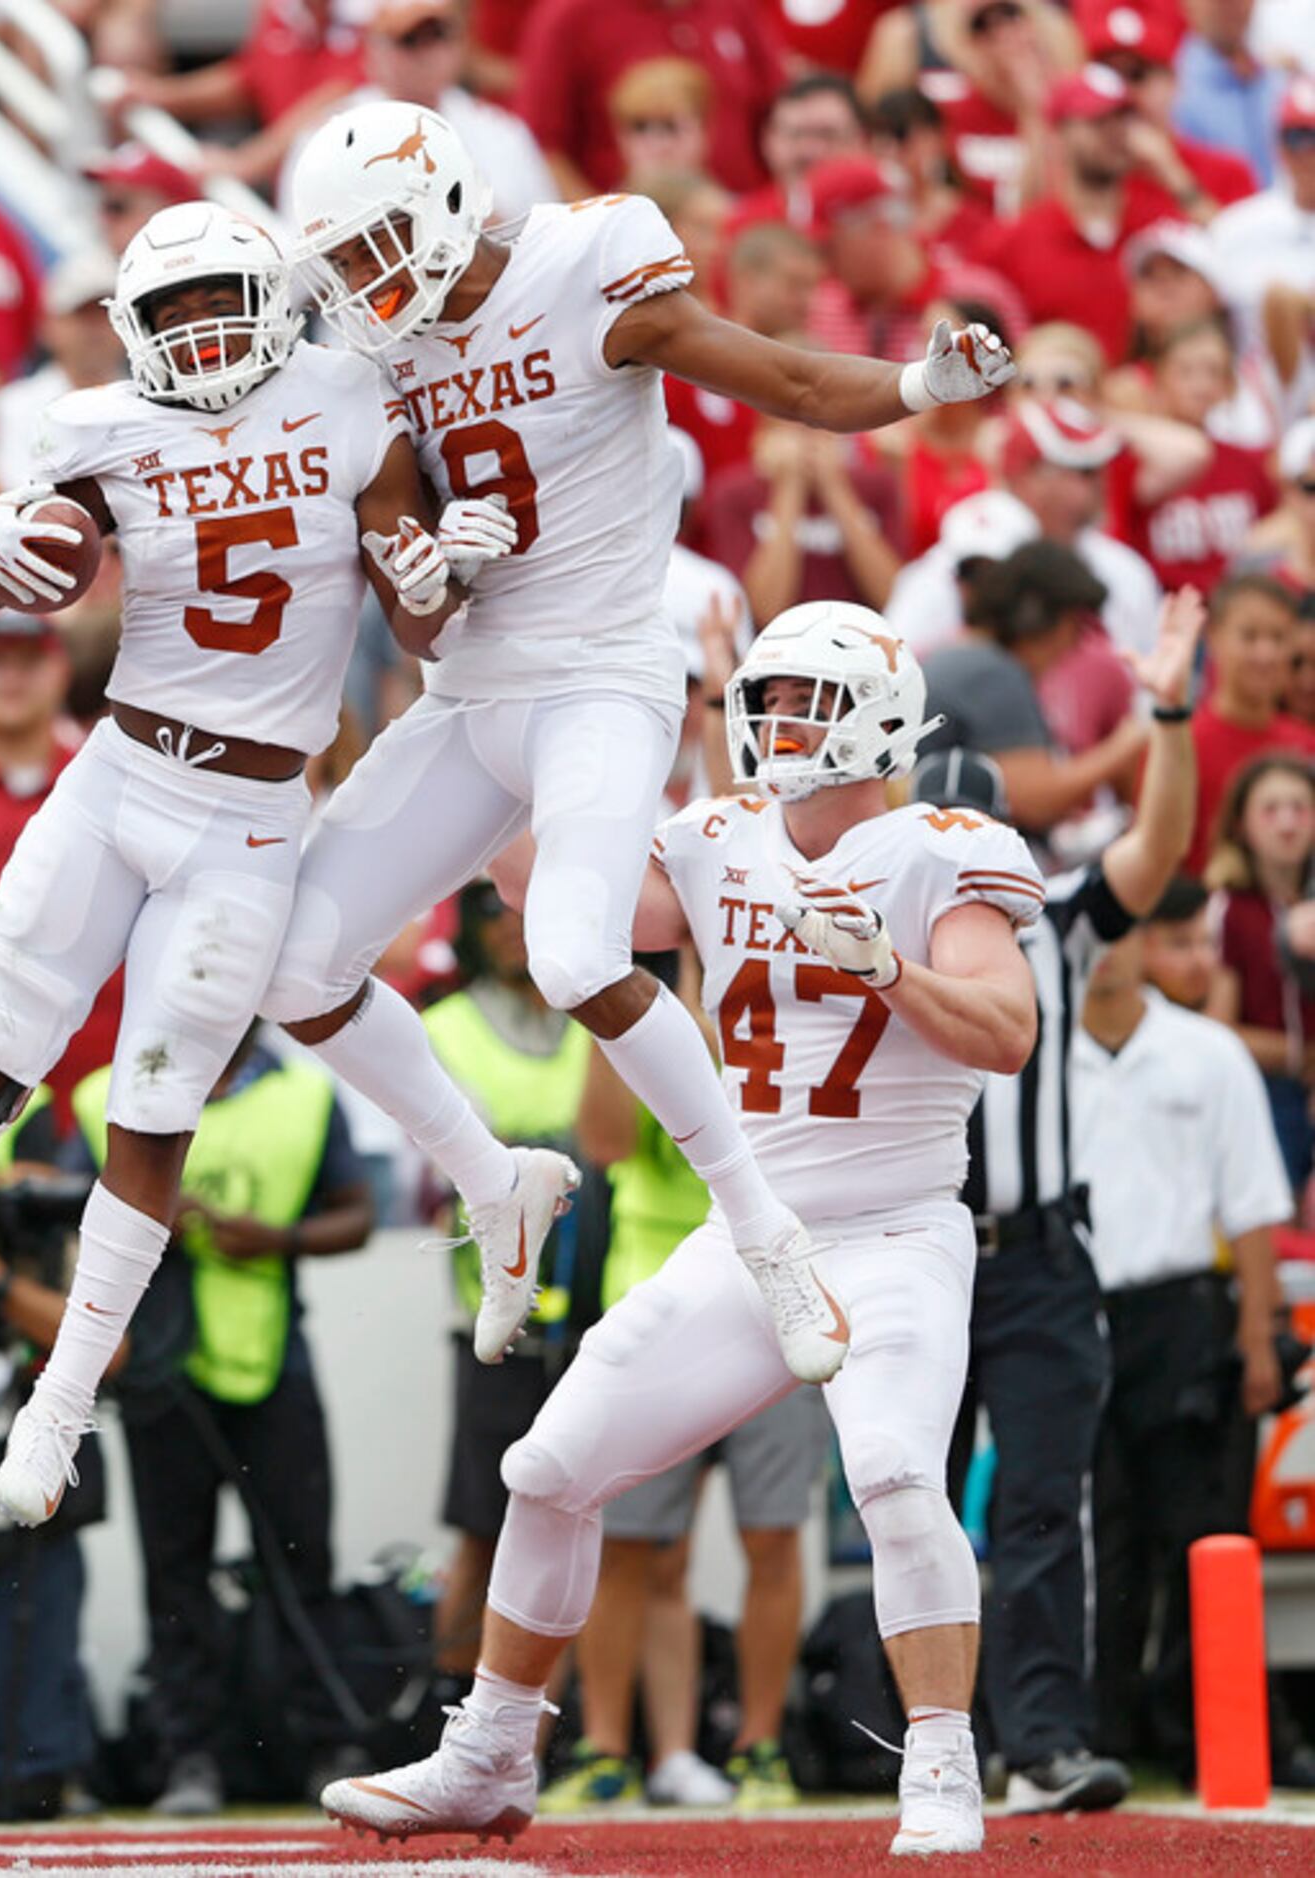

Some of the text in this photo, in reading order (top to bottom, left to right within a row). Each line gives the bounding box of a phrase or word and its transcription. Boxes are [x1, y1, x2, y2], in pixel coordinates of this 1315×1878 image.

[403, 349, 556, 435] TEXAS
[143, 446, 330, 517] TEXAS
[439, 418, 541, 556] 9
[183, 505, 301, 656] 5
[701, 814, 727, 839] C
[718, 957, 893, 1119] 47
